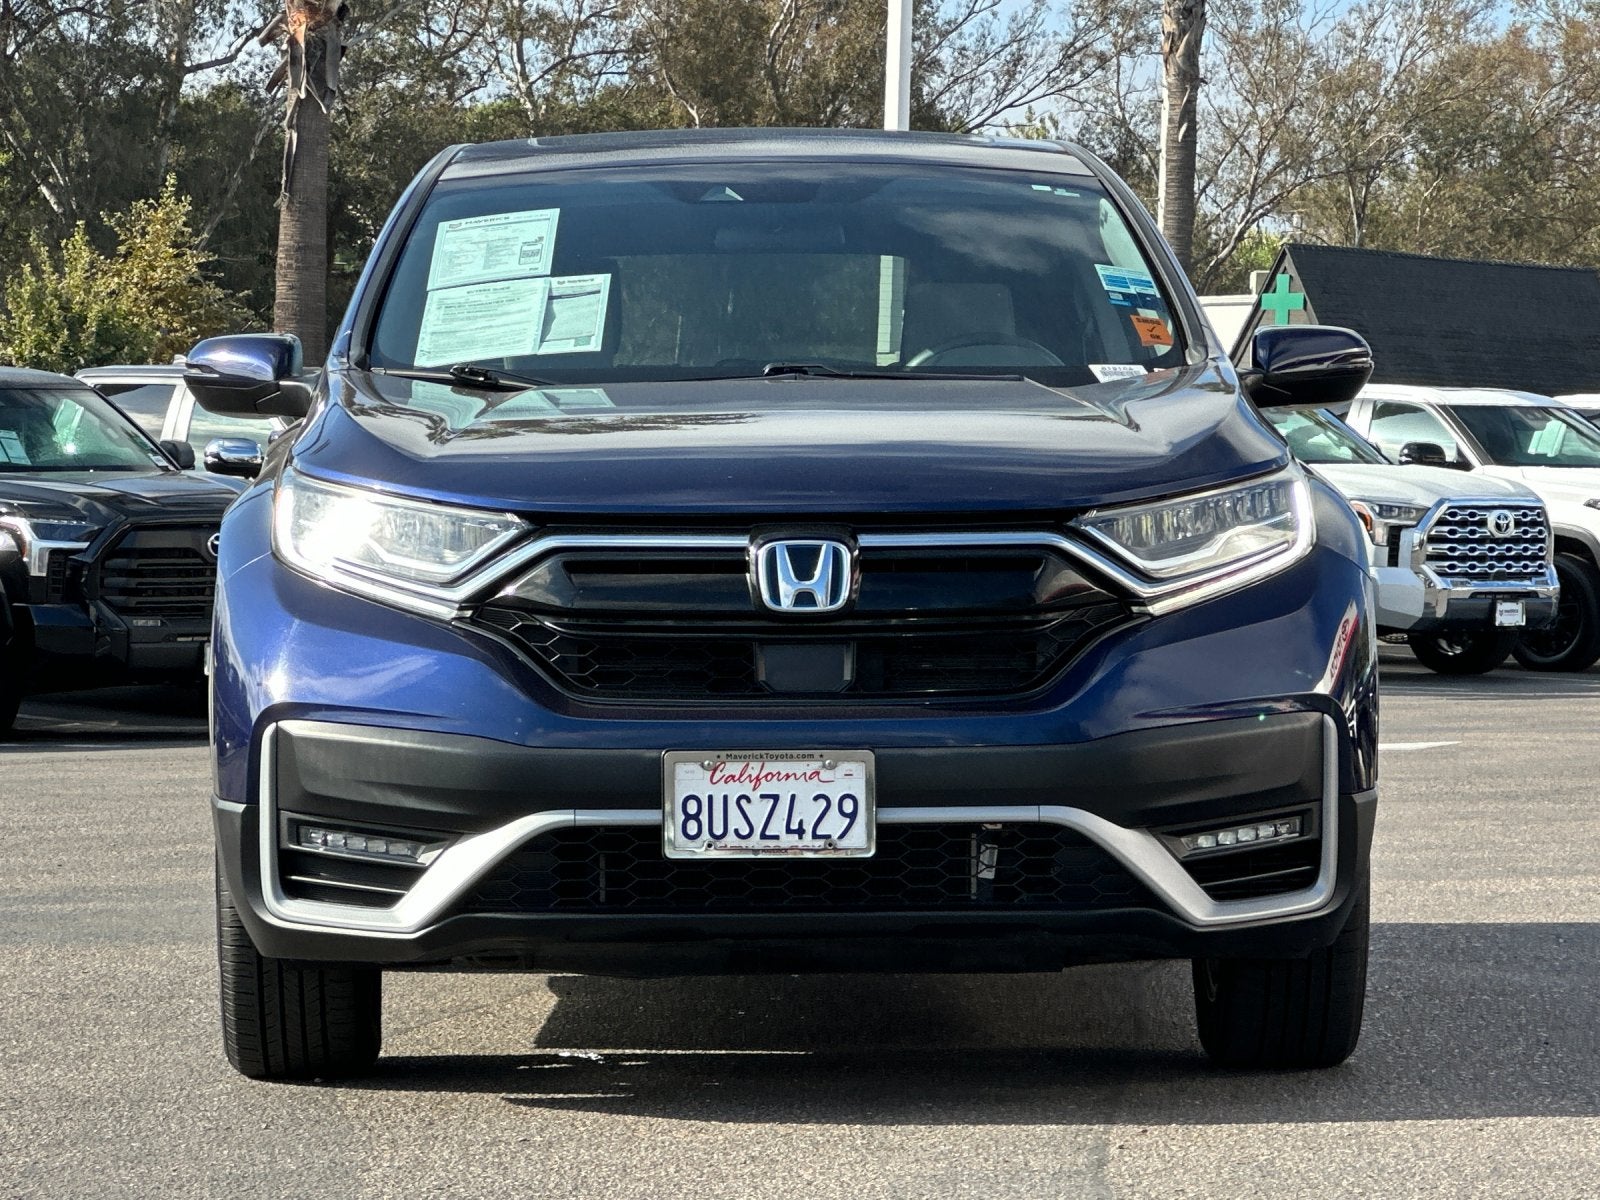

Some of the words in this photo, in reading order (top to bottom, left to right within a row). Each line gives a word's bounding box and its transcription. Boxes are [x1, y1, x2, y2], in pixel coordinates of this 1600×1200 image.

[725, 753, 815, 761] MaverickToyota.com
[709, 762, 835, 791] California
[681, 793, 859, 841] 8USZ429
